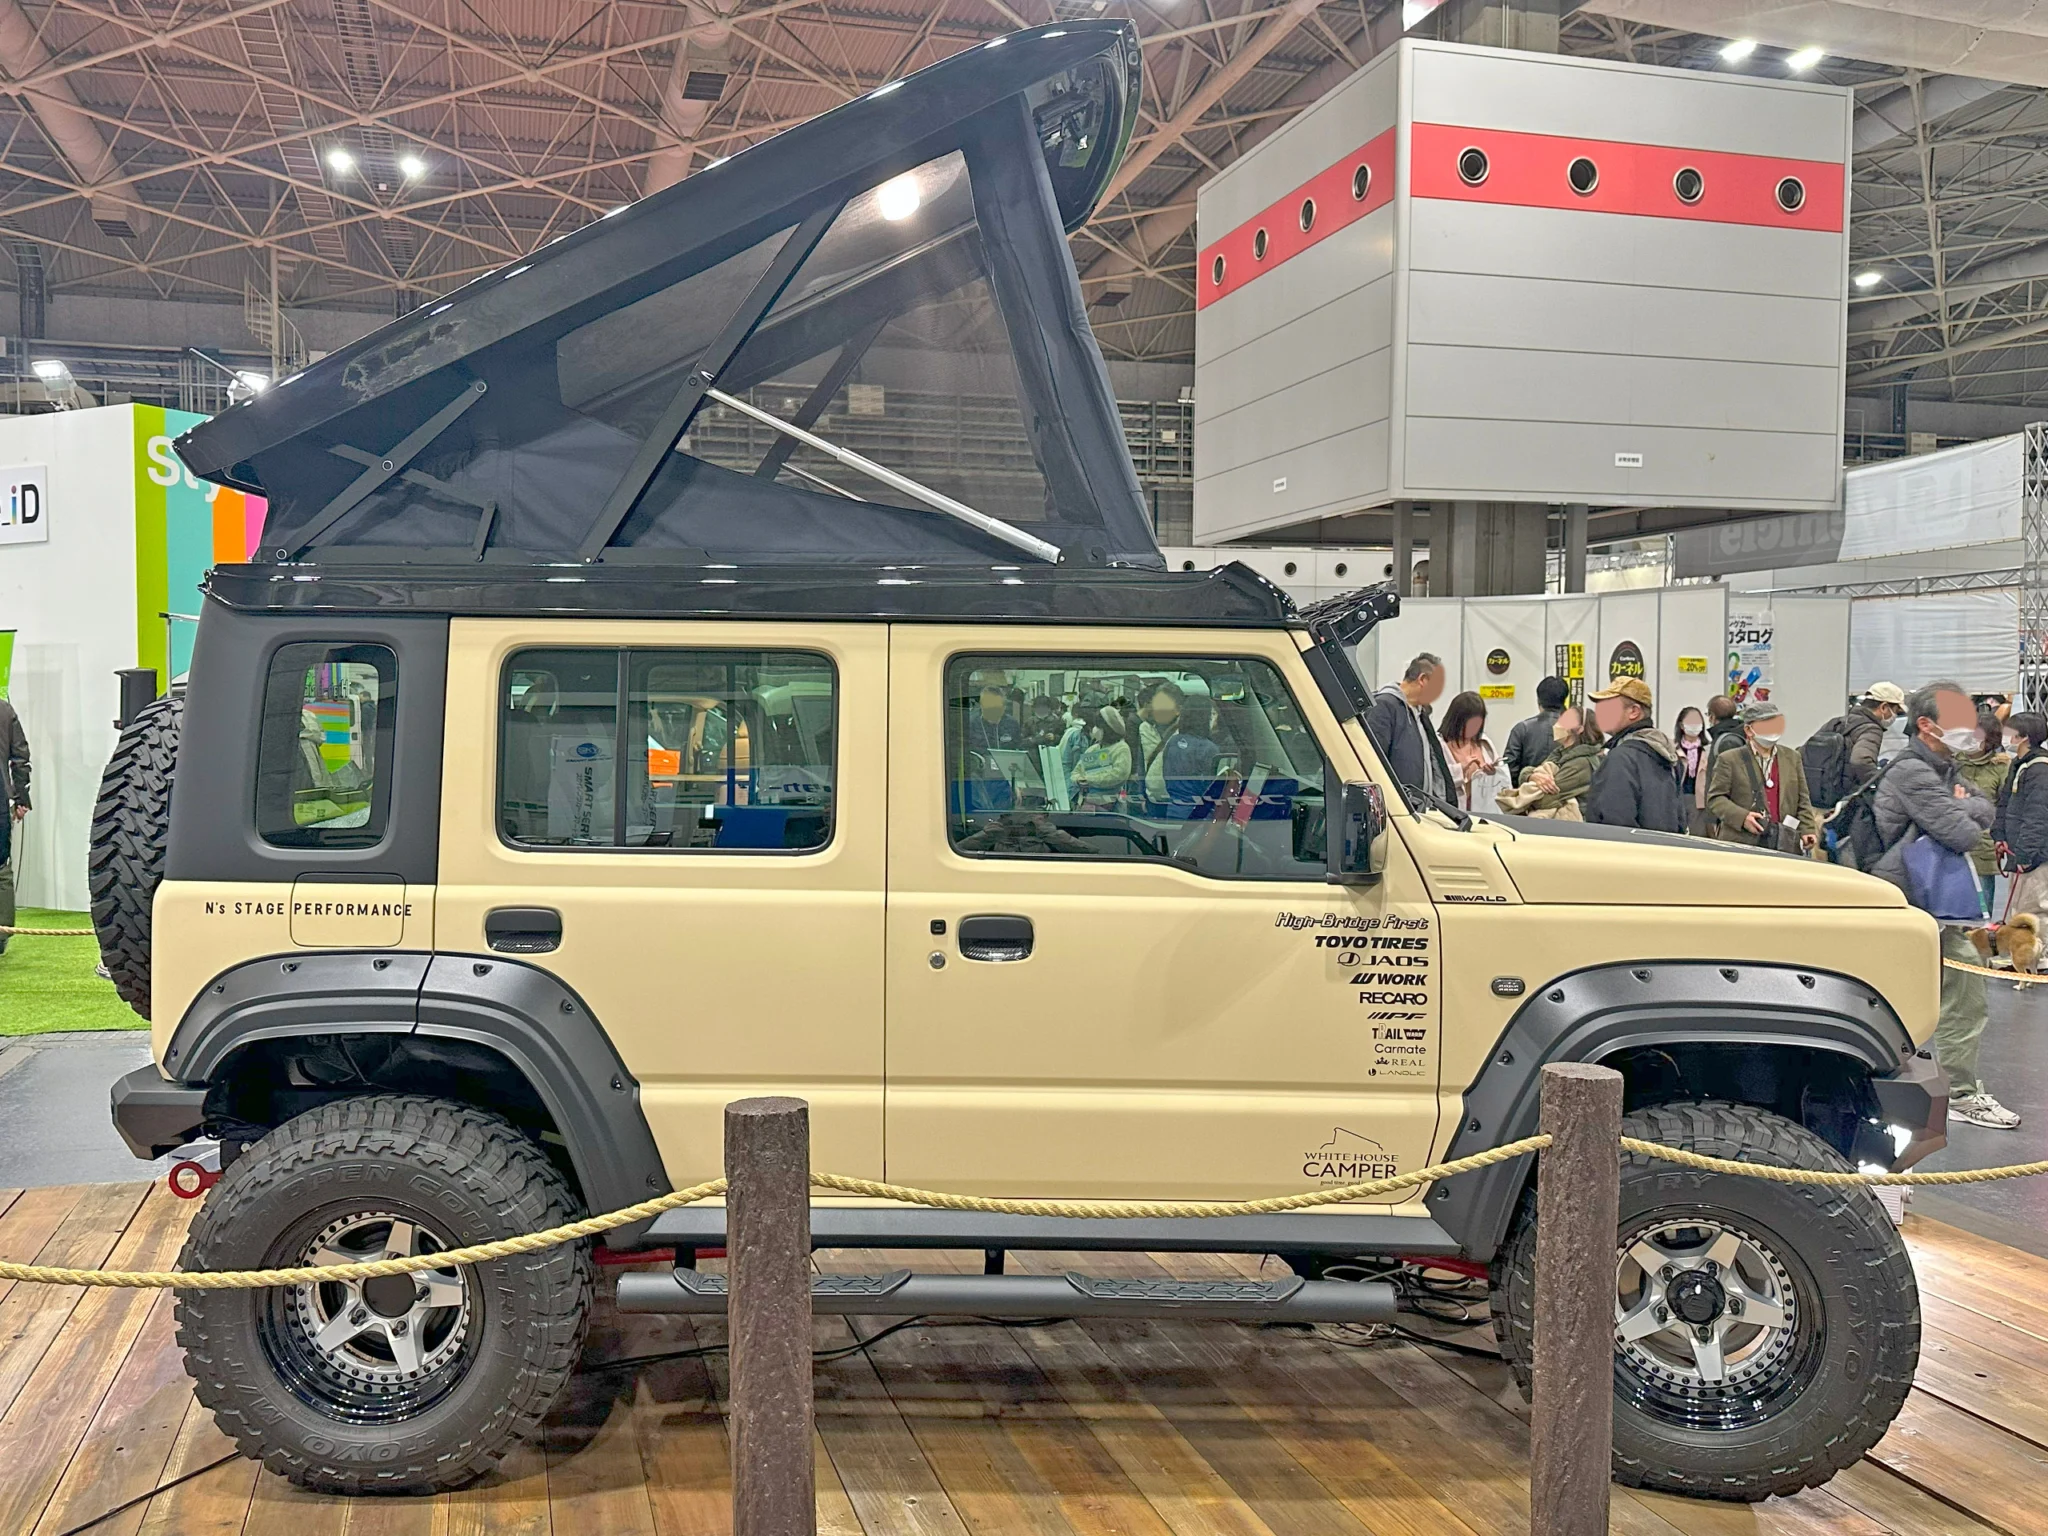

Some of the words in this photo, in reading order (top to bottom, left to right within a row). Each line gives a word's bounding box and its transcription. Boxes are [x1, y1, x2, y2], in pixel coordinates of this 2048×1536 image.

[1610, 661, 1643, 676] カーネル
[1461, 895, 1507, 903] WALD
[205, 902, 226, 915] N's
[234, 902, 285, 915] STAGE
[293, 903, 413, 917] PERFORMANCE
[1275, 912, 1381, 932] High-Bridge
[1382, 914, 1429, 931] First
[1315, 936, 1368, 948] TOYO
[1370, 937, 1429, 950] TIRES
[1361, 955, 1429, 967] JAOS
[1376, 973, 1428, 986] WORK
[1359, 991, 1428, 1006] RECARO
[1371, 1023, 1403, 1040] TRAIL
[1374, 1043, 1427, 1055] Carmate
[1391, 1059, 1426, 1067] REAL
[1304, 1152, 1352, 1161] WHITE
[1353, 1153, 1400, 1163] HOUSE
[1302, 1161, 1397, 1180] CAMPER
[280, 1164, 396, 1204] OPEN
[300, 1432, 438, 1462] TOYO
